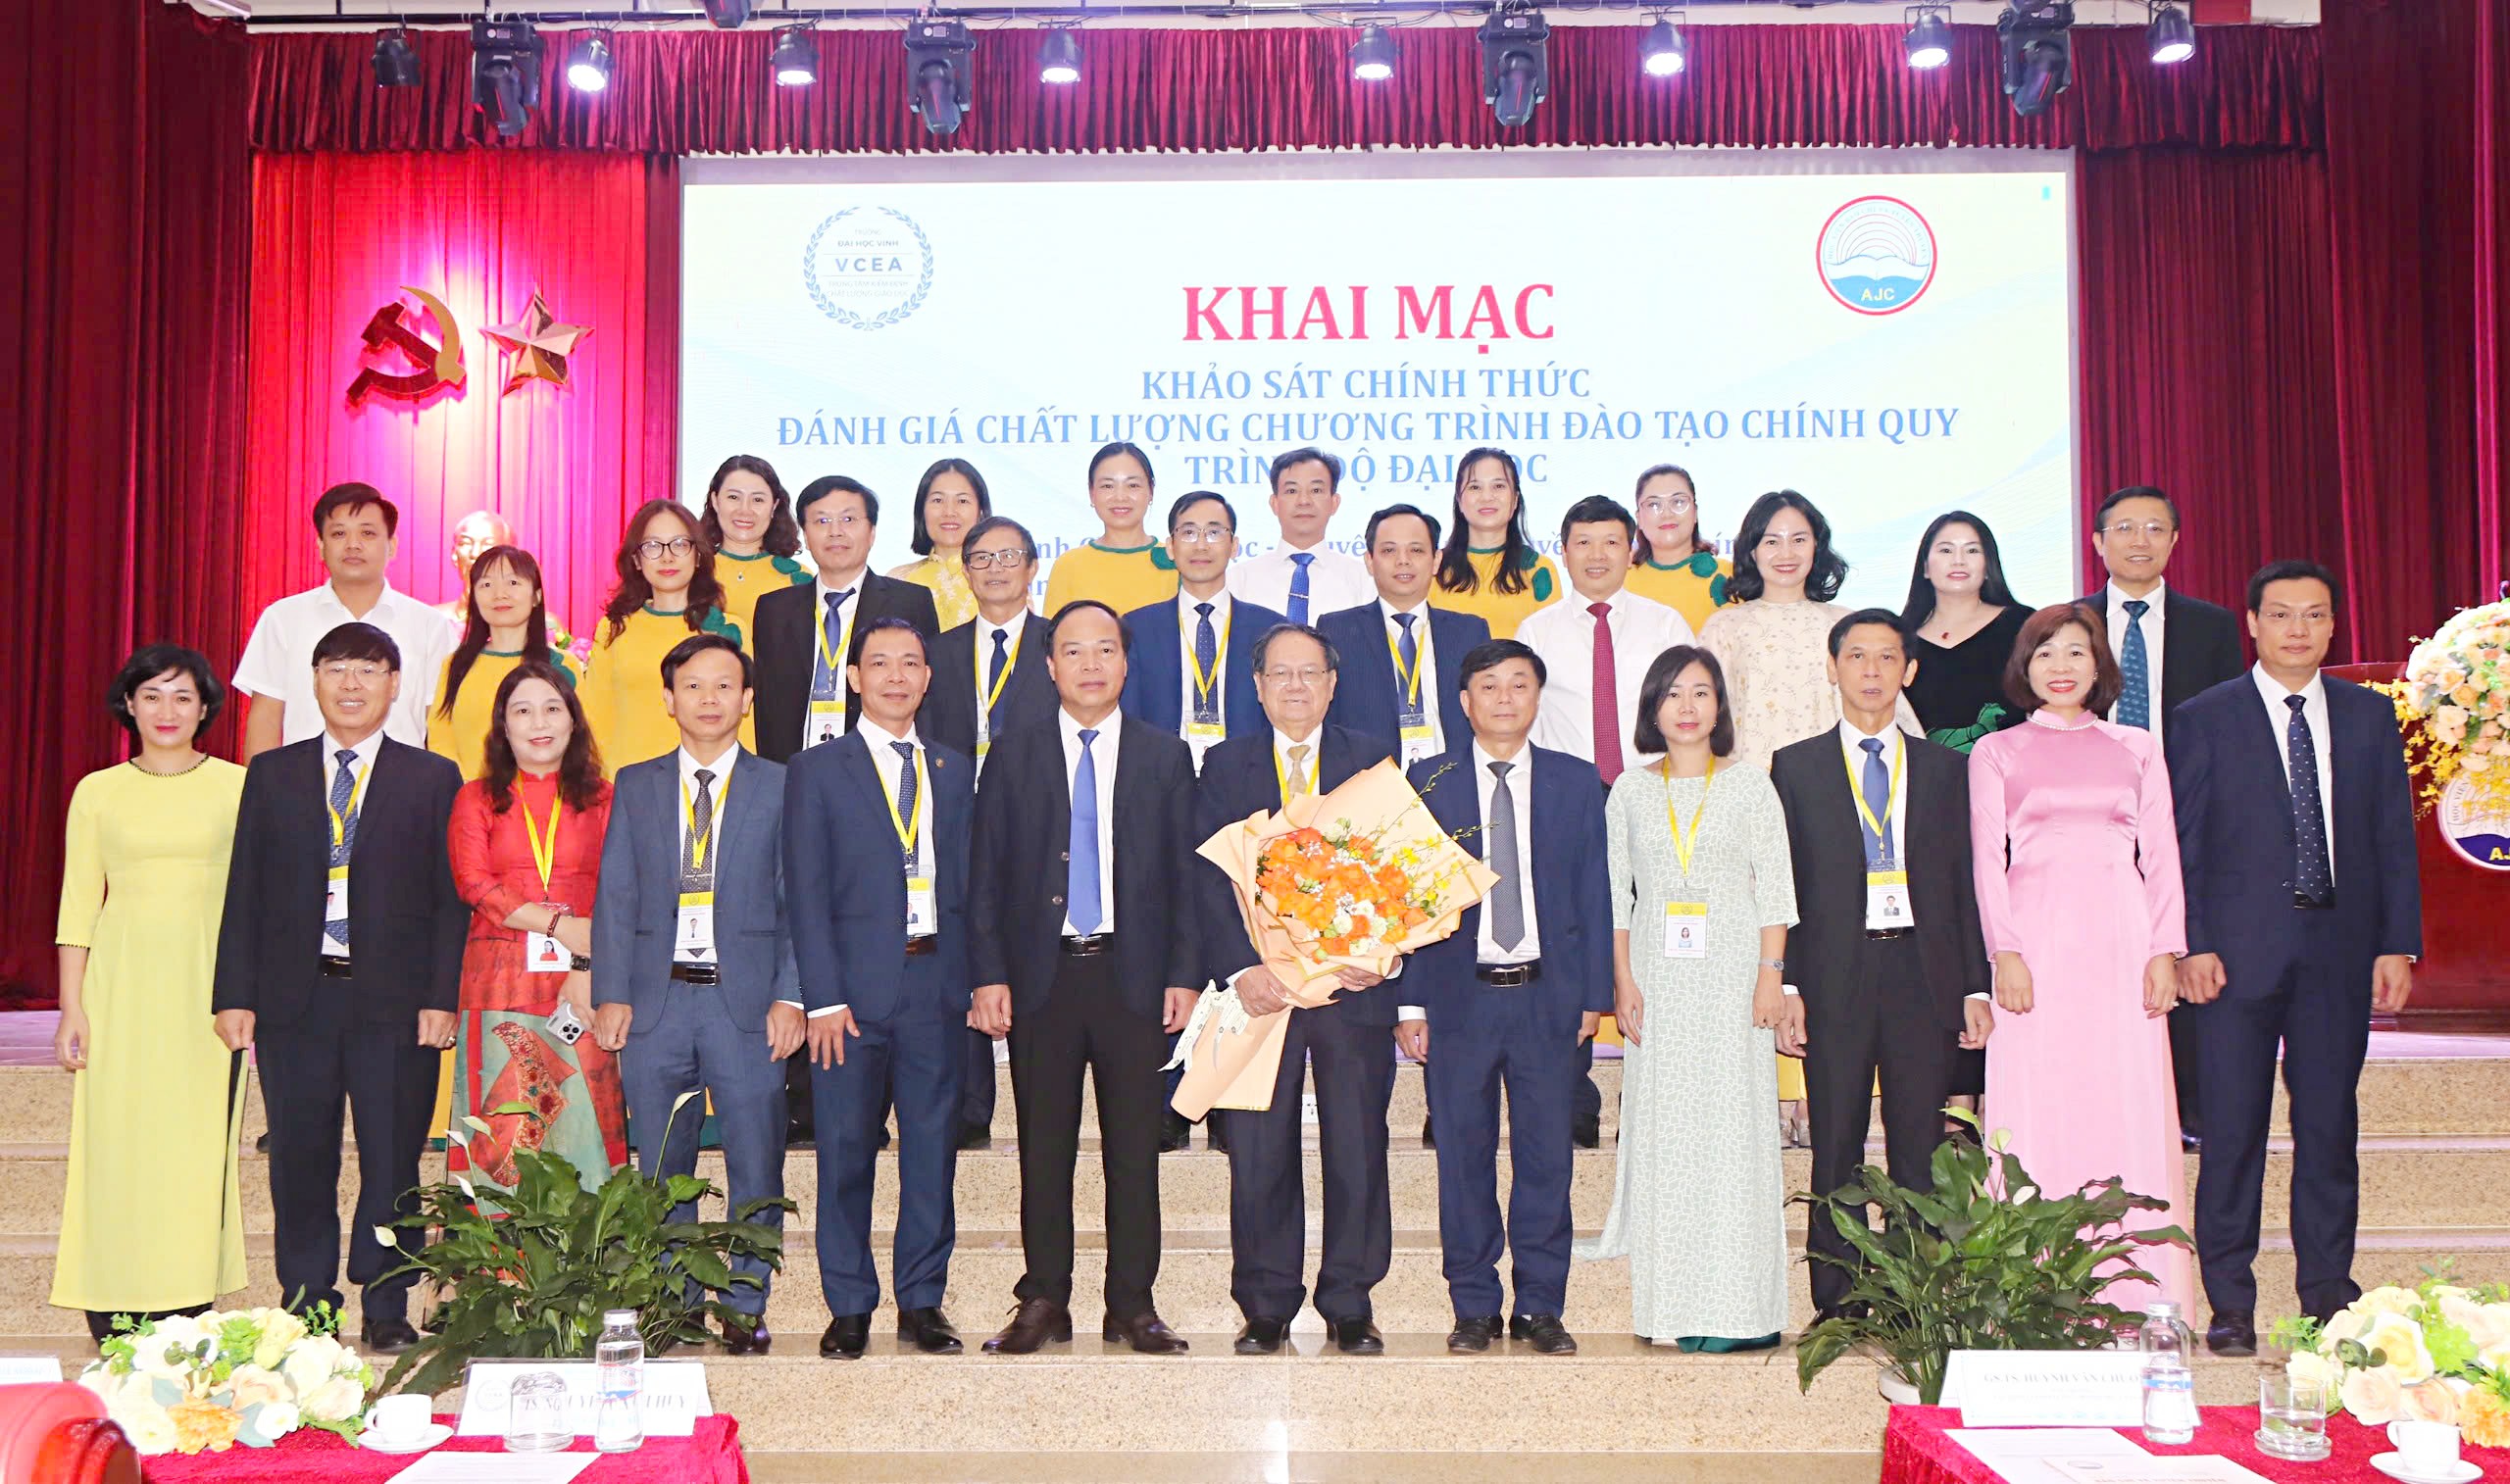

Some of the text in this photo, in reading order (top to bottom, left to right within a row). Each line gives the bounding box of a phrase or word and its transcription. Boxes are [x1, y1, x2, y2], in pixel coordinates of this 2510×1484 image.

[835, 257, 903, 272] VCEA
[1861, 287, 1895, 302] AJC
[1182, 284, 1554, 355] KHAI MẠC
[1142, 361, 1590, 400] KHẢO SÁT CHÍNH THỨC
[778, 402, 1959, 451] ĐÁNH GIÁ CHẤT LƯỢNG CHƯƠNG TRÌNH ĐÀO TẠO CHÍNH QUY
[1184, 450, 1273, 484] TRÌN
[1388, 455, 1455, 490] ĐẠI
